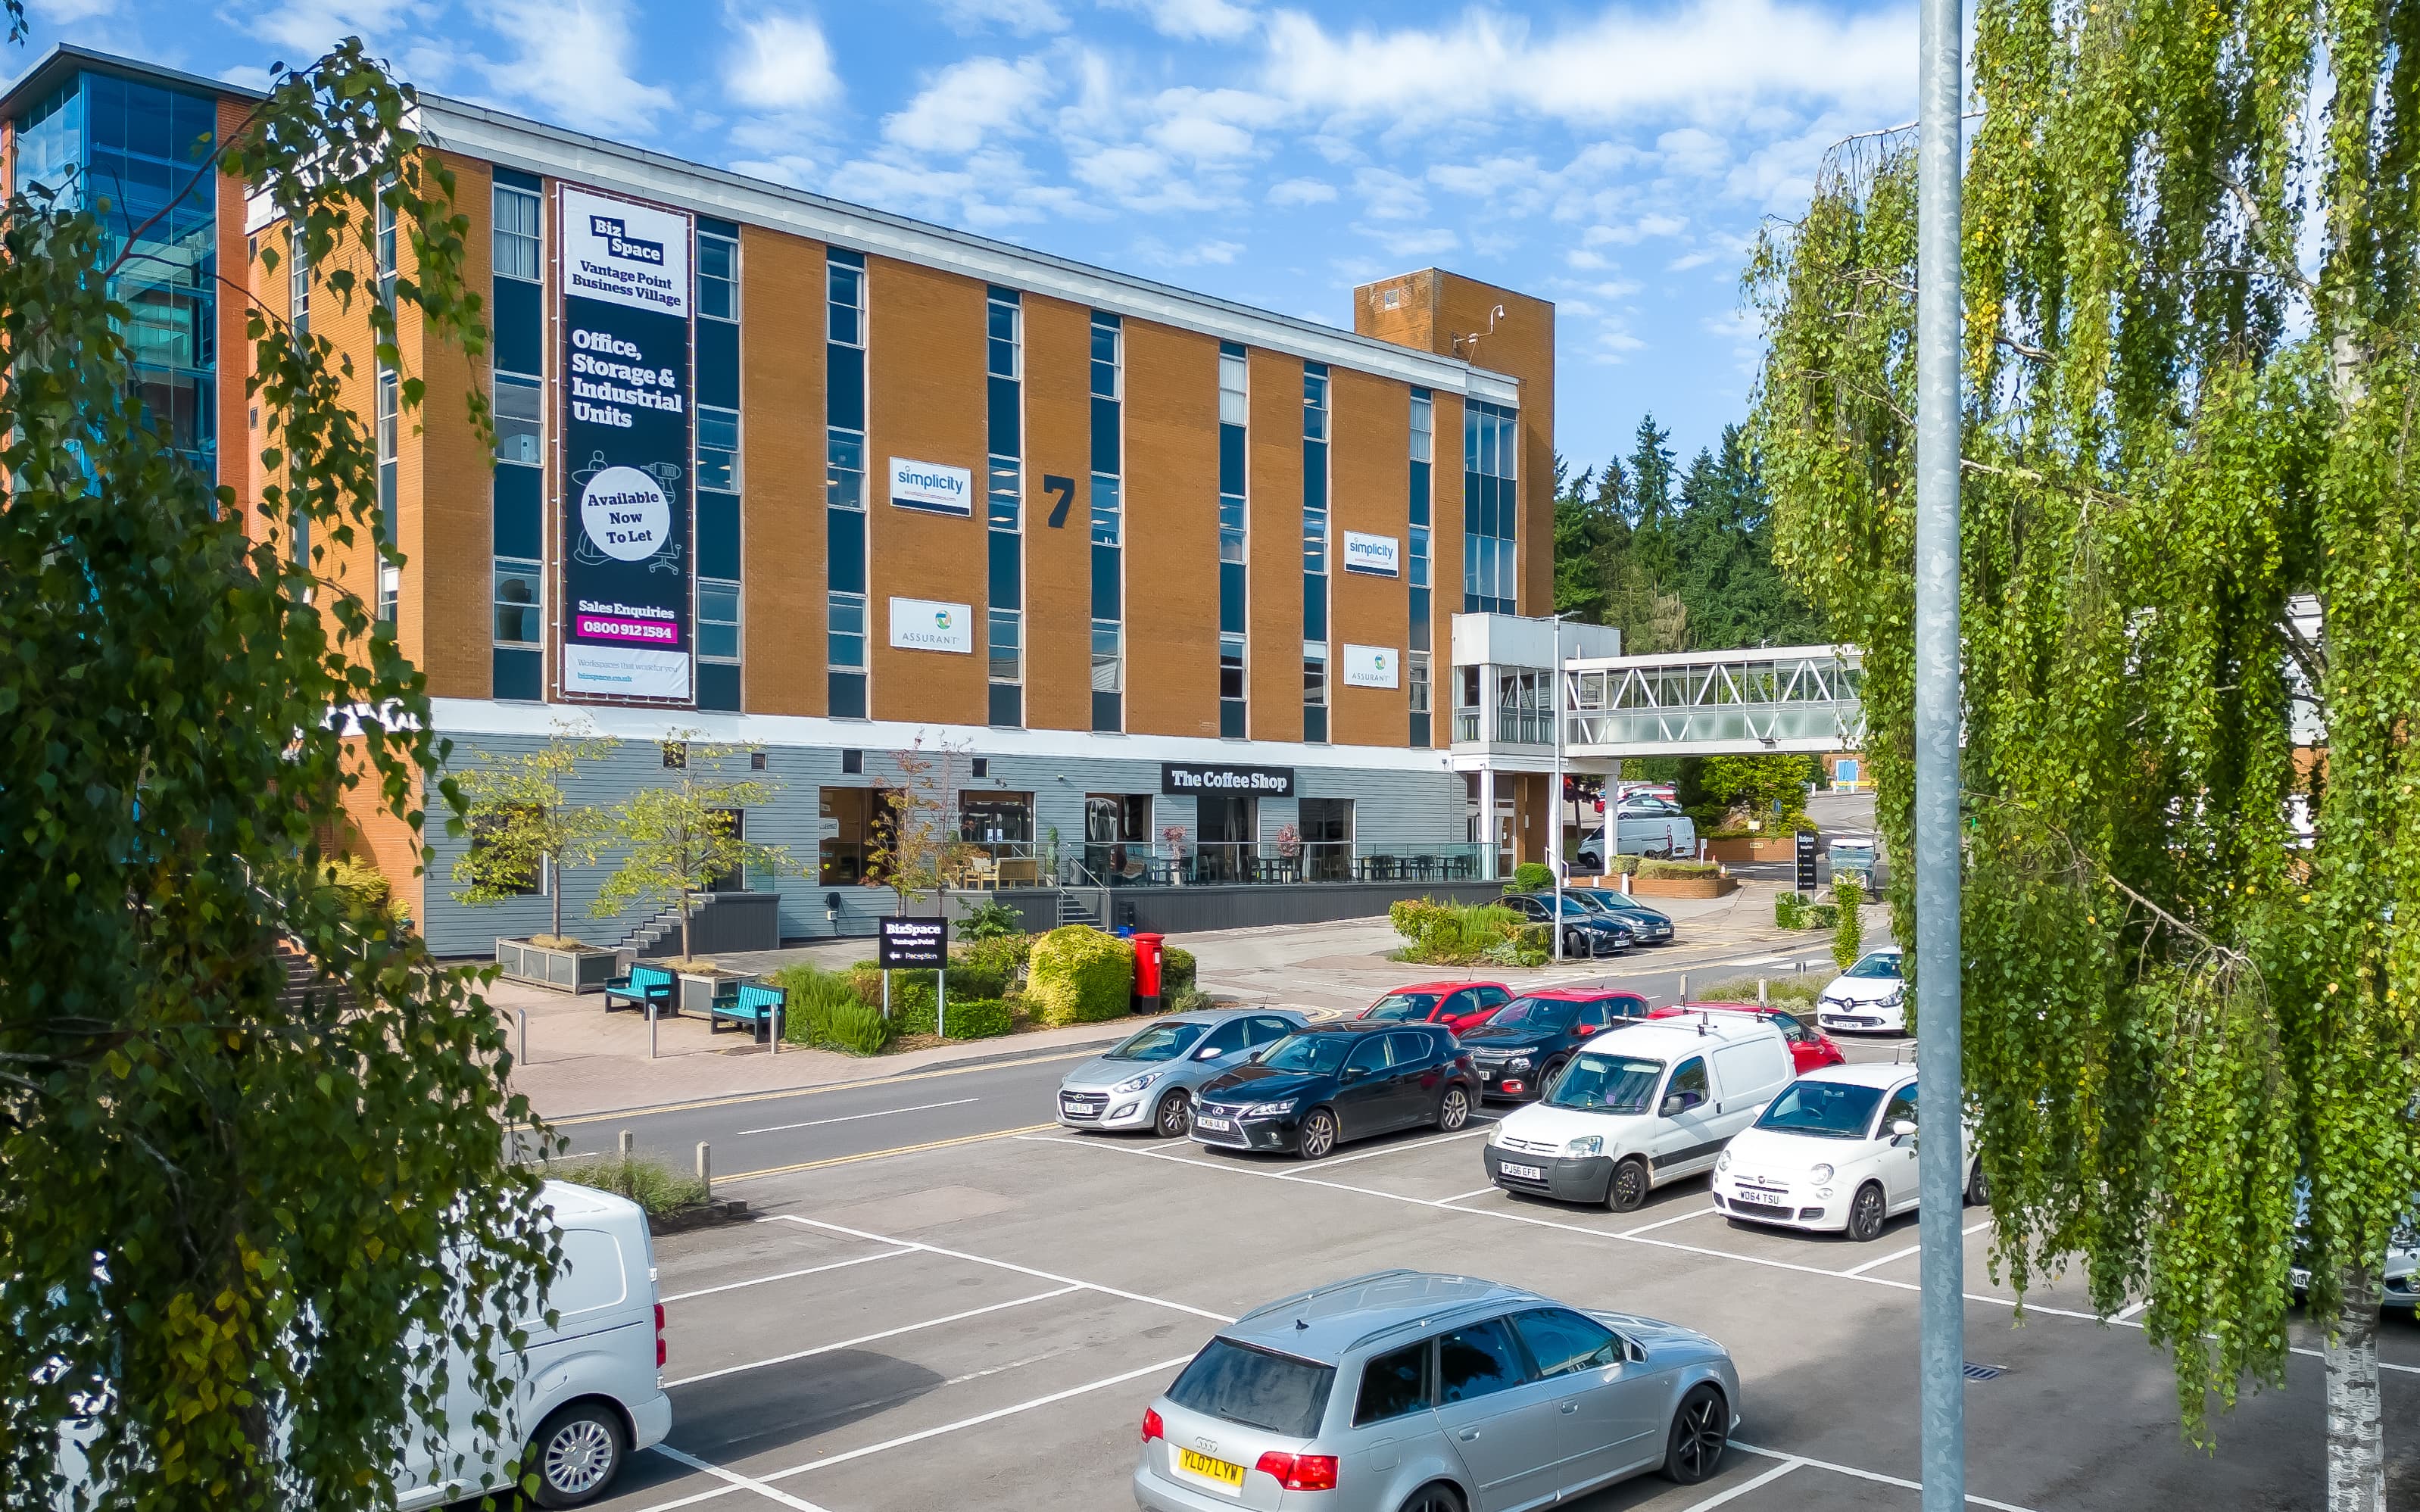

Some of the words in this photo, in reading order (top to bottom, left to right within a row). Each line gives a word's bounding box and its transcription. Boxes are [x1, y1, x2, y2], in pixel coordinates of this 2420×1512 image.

[594, 218, 622, 238] Biz
[611, 238, 661, 260] Space
[580, 260, 635, 282] Vantage
[637, 272, 672, 290] Point
[572, 273, 634, 296] Business
[635, 286, 681, 307] Village
[572, 329, 642, 361] Office,
[572, 353, 656, 386] Storage
[658, 368, 675, 388] &
[572, 376, 683, 413] Industrial
[572, 401, 632, 428] Units
[898, 466, 963, 494] simplicity
[588, 491, 660, 507] Available
[1043, 473, 1075, 528] 7
[609, 512, 643, 525] Now
[606, 532, 626, 544] To
[628, 530, 652, 542] Let
[1350, 537, 1393, 560] simplicity
[578, 600, 613, 614] Sales
[613, 603, 675, 619] Enquiries
[583, 621, 619, 634] 0800
[620, 624, 642, 636] 912
[643, 625, 672, 638] 1584
[902, 631, 958, 645] ASSURANT
[577, 659, 620, 669] Workspaces
[1352, 672, 1389, 682] ASSURANT
[1171, 770, 1202, 787] The
[1203, 772, 1249, 788] Coffee
[1251, 773, 1287, 792] Shop
[886, 923, 941, 937] BizSpace
[891, 938, 917, 946] Vantage
[905, 952, 937, 961] Reception
[1504, 1164, 1522, 1175] PJ56
[1523, 1167, 1537, 1177] EFE
[1763, 1194, 1779, 1205] TSU
[1183, 1450, 1212, 1474] YL07
[1215, 1458, 1238, 1482] LYW
